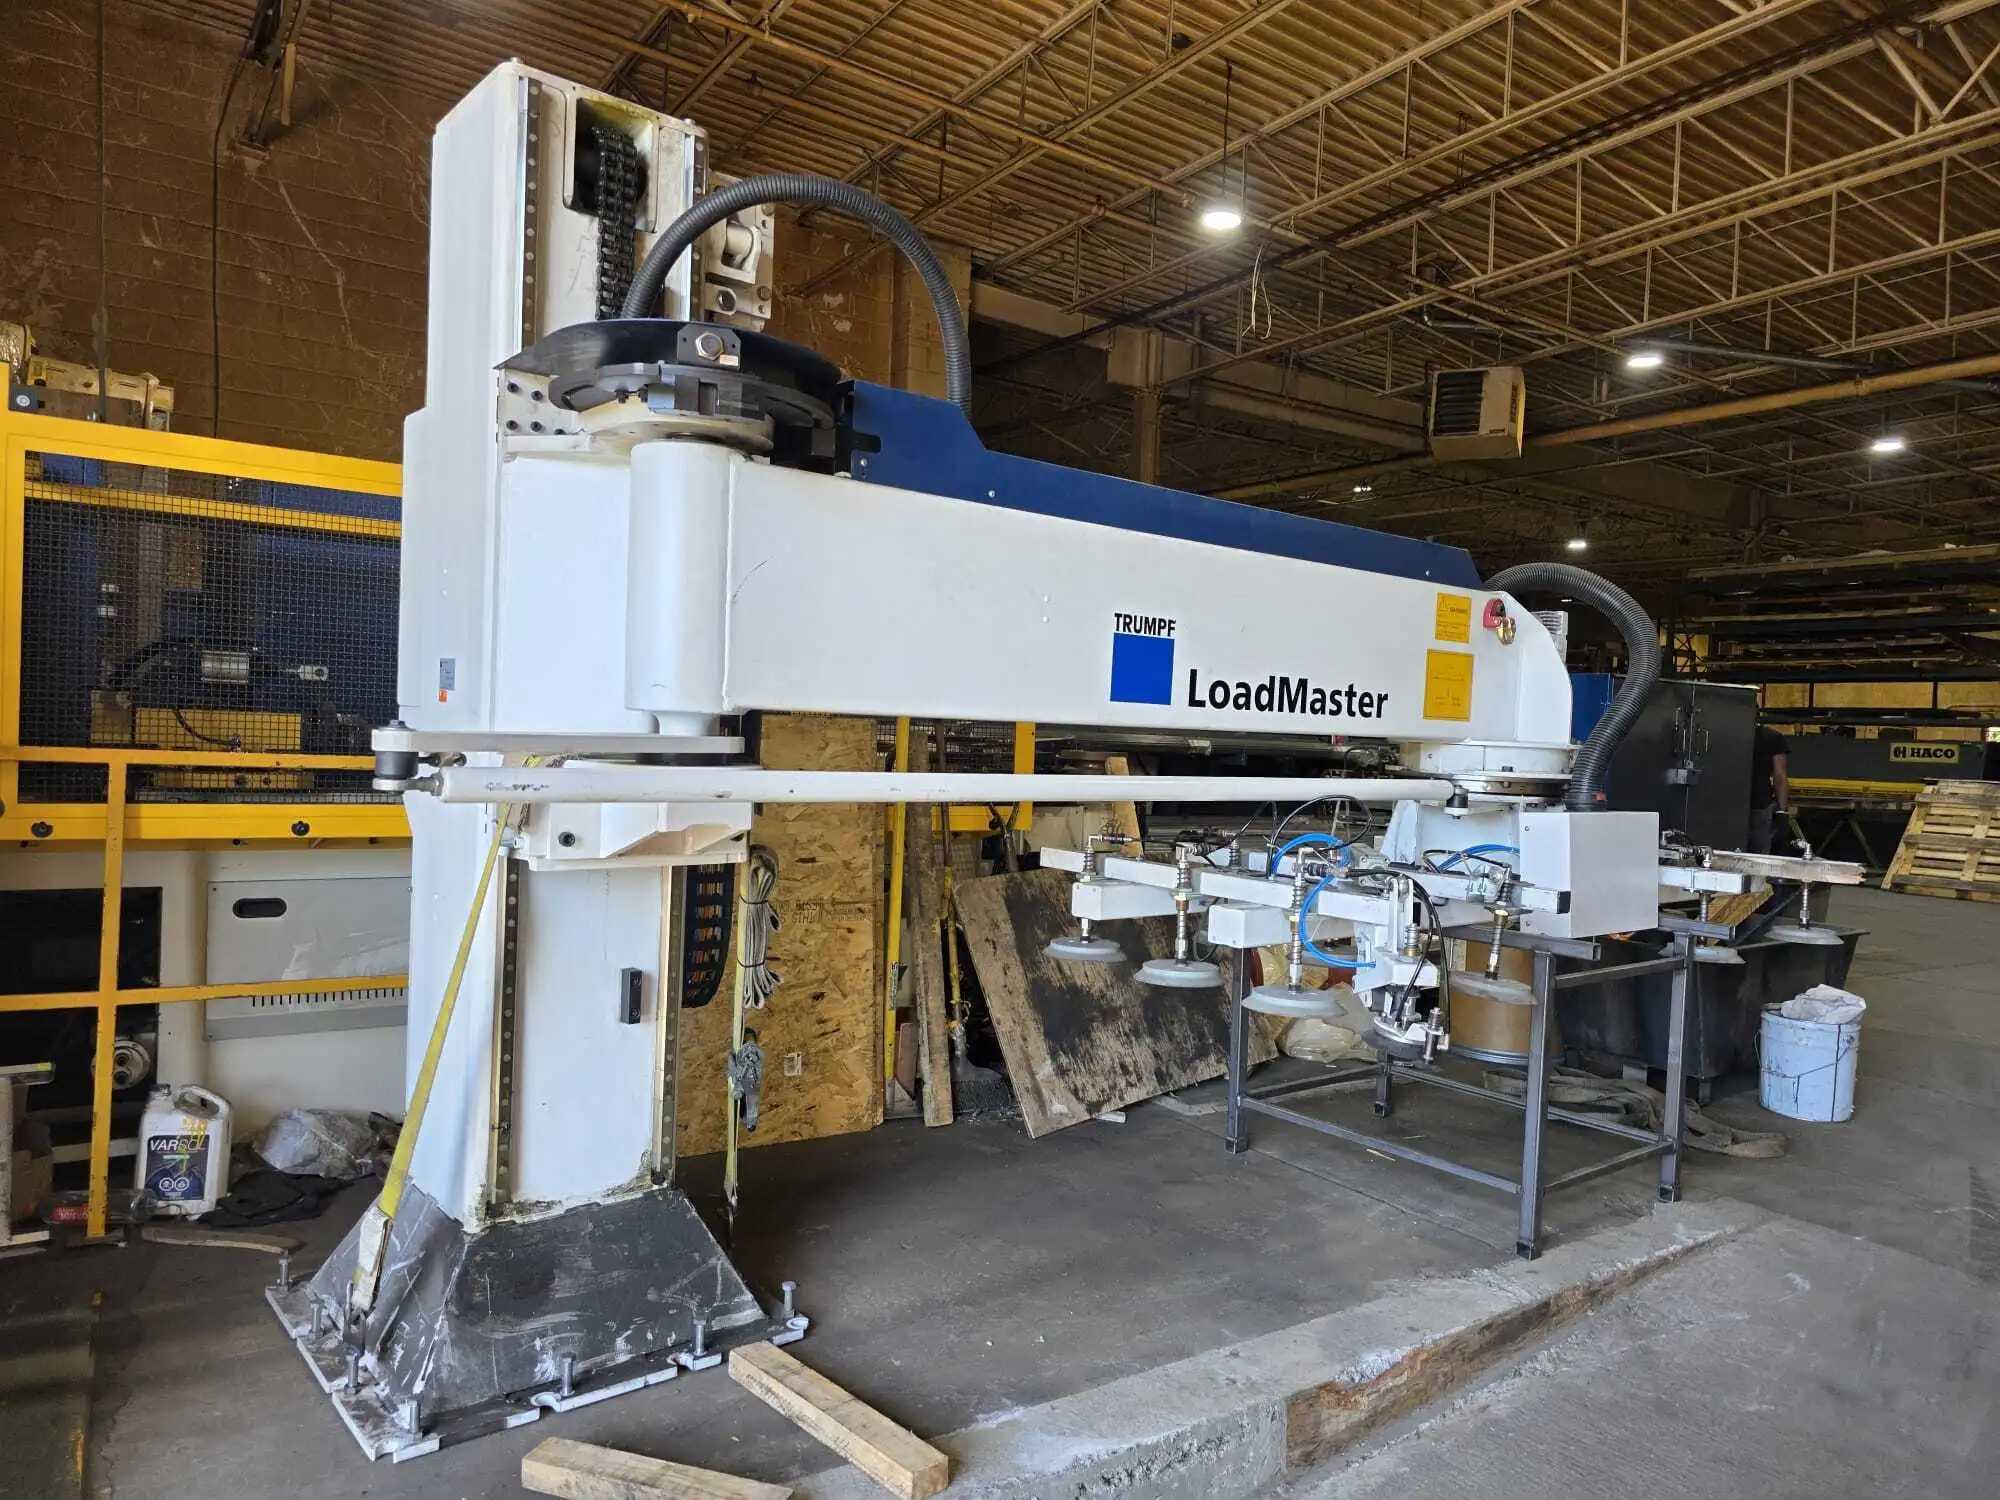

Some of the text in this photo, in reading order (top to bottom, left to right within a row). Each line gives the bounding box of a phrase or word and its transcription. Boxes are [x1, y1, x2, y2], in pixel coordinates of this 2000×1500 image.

[1114, 612, 1176, 636] TRUMPF
[1187, 668, 1389, 719] LoadMaster
[1910, 747, 1955, 758] HACO
